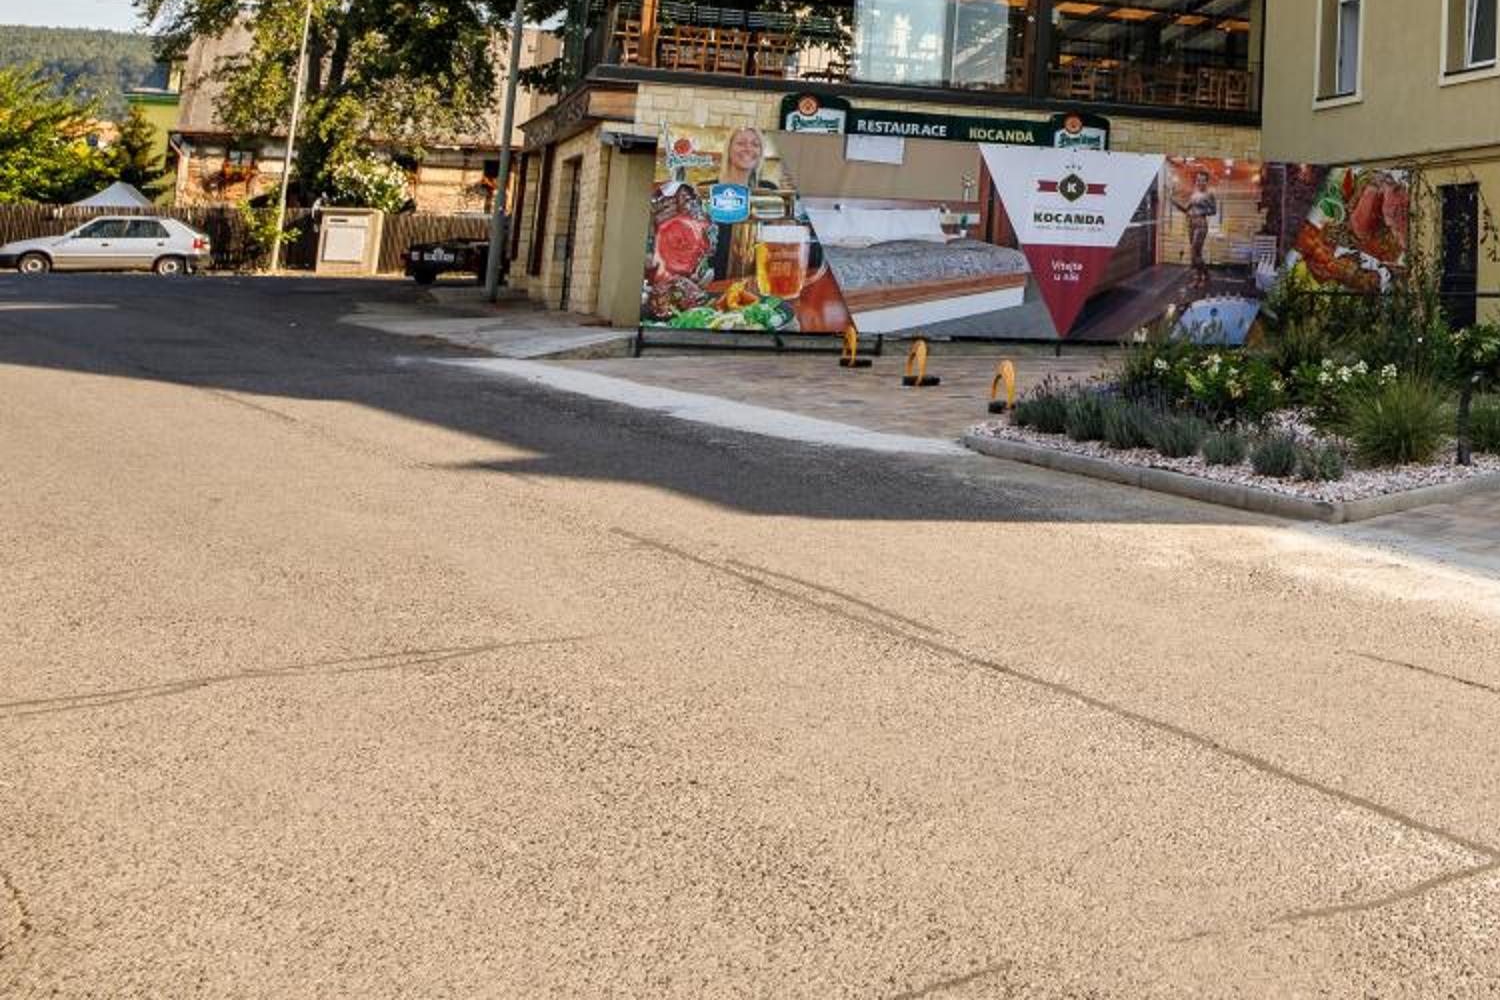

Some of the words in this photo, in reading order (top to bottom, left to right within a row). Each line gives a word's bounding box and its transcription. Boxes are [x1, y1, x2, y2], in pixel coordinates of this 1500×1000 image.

[857, 119, 948, 137] RESTAURACE
[969, 127, 1035, 143] KOCANDA
[1067, 182, 1077, 193] K
[1033, 211, 1105, 225] KOCANDA
